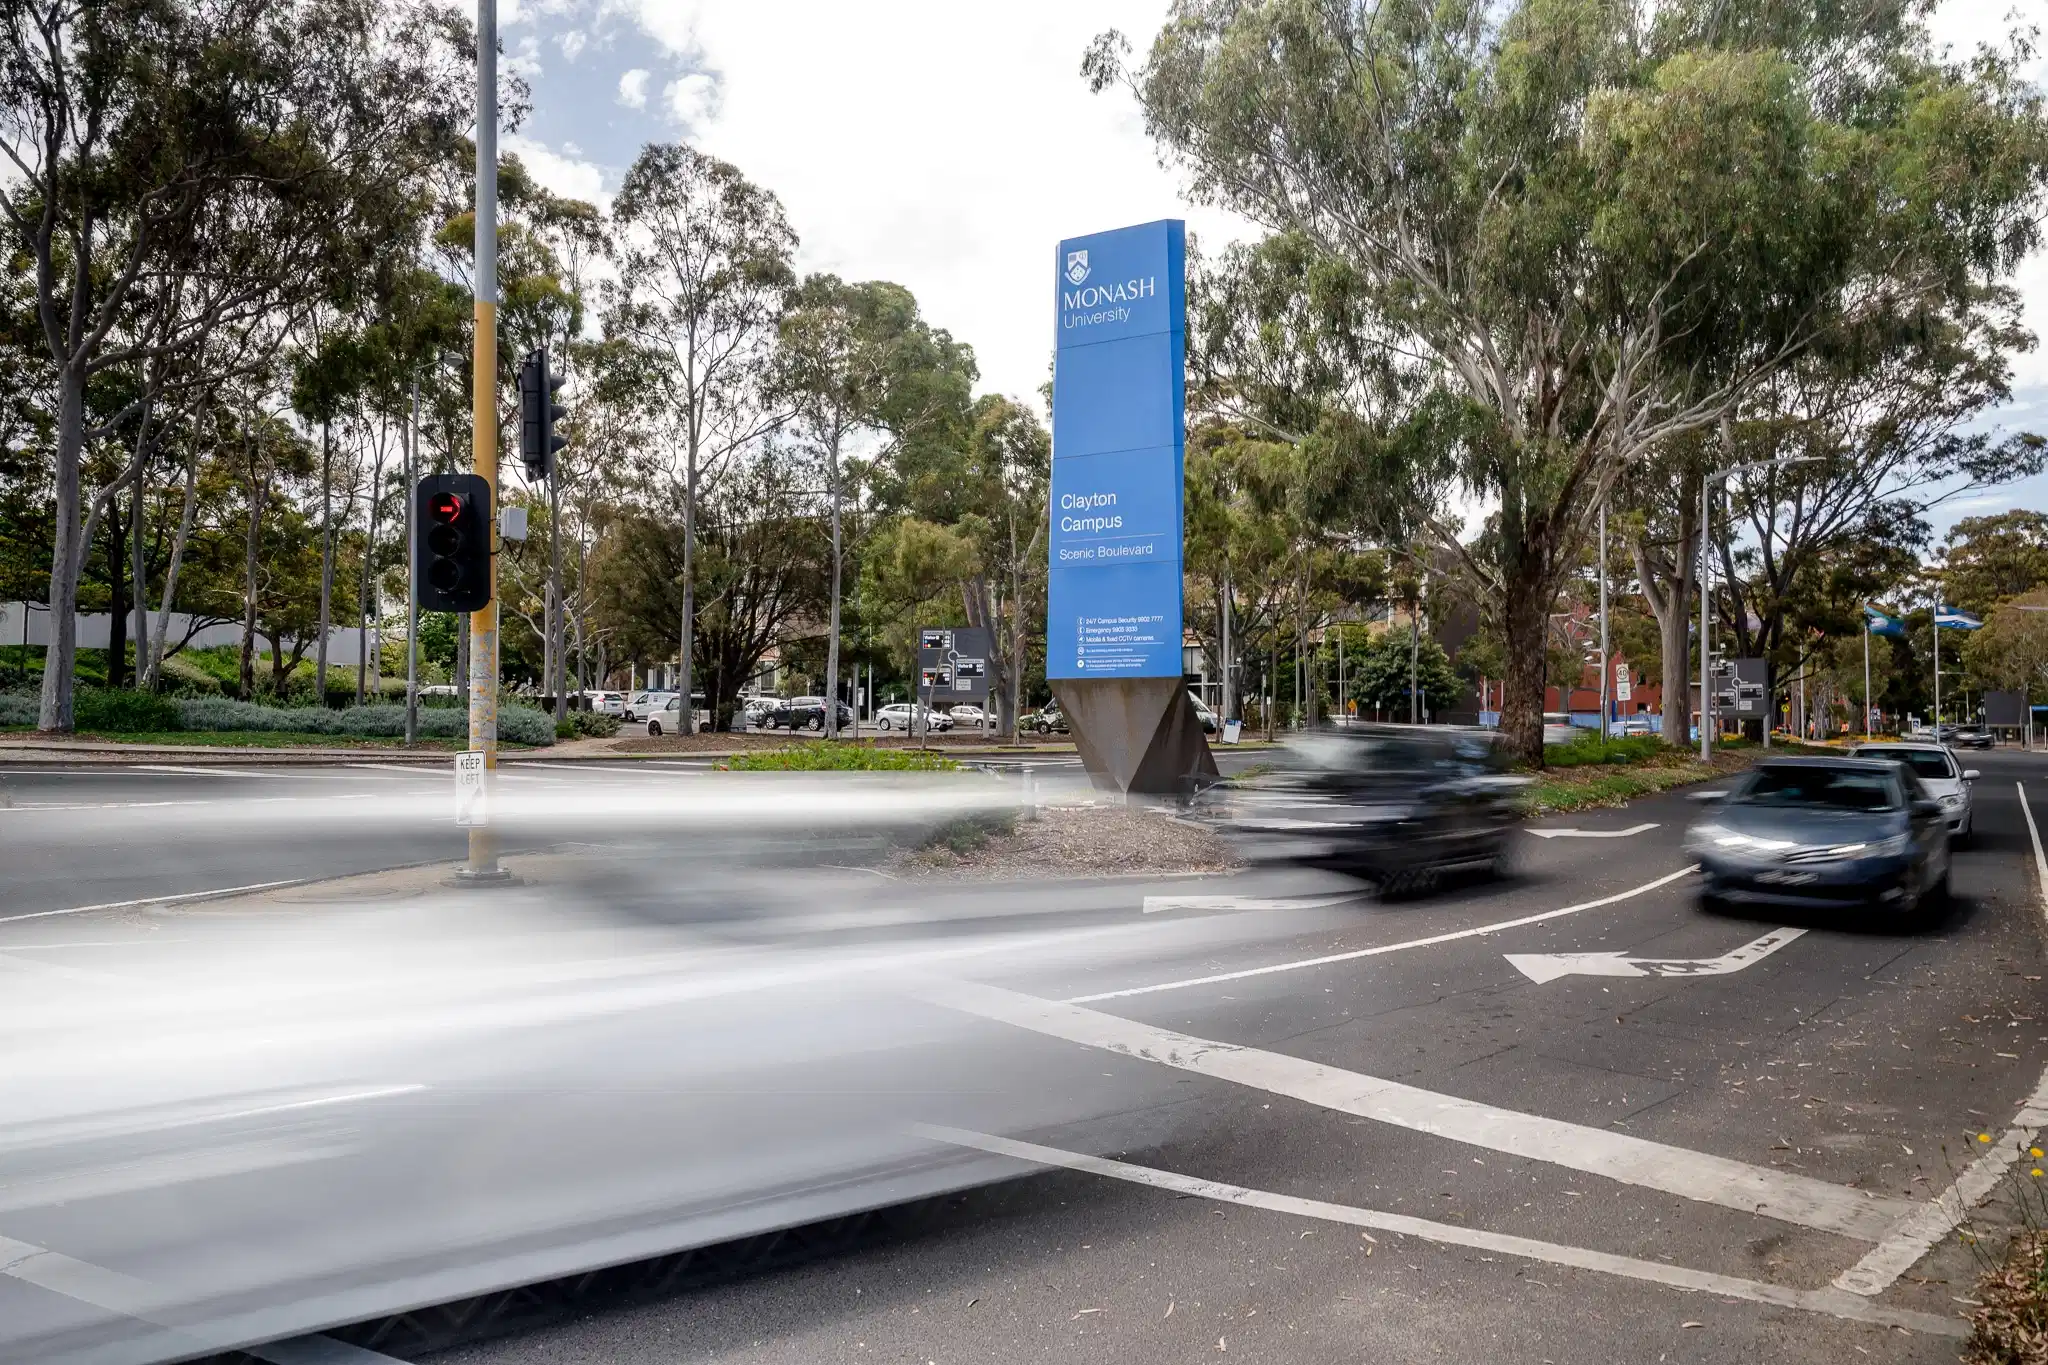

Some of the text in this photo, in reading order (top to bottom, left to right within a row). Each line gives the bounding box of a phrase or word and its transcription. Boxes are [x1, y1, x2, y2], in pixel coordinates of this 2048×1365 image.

[1064, 276, 1155, 311] MONASH
[1064, 306, 1131, 329] University
[1061, 492, 1117, 511] Clayton
[1061, 515, 1123, 533] Campus
[1059, 543, 1153, 560] Scenic Boulevard
[1097, 617, 1117, 625] Campus
[1085, 627, 1111, 635] Emergency
[460, 758, 480, 770] KEEP
[460, 773, 480, 785] LEFT
